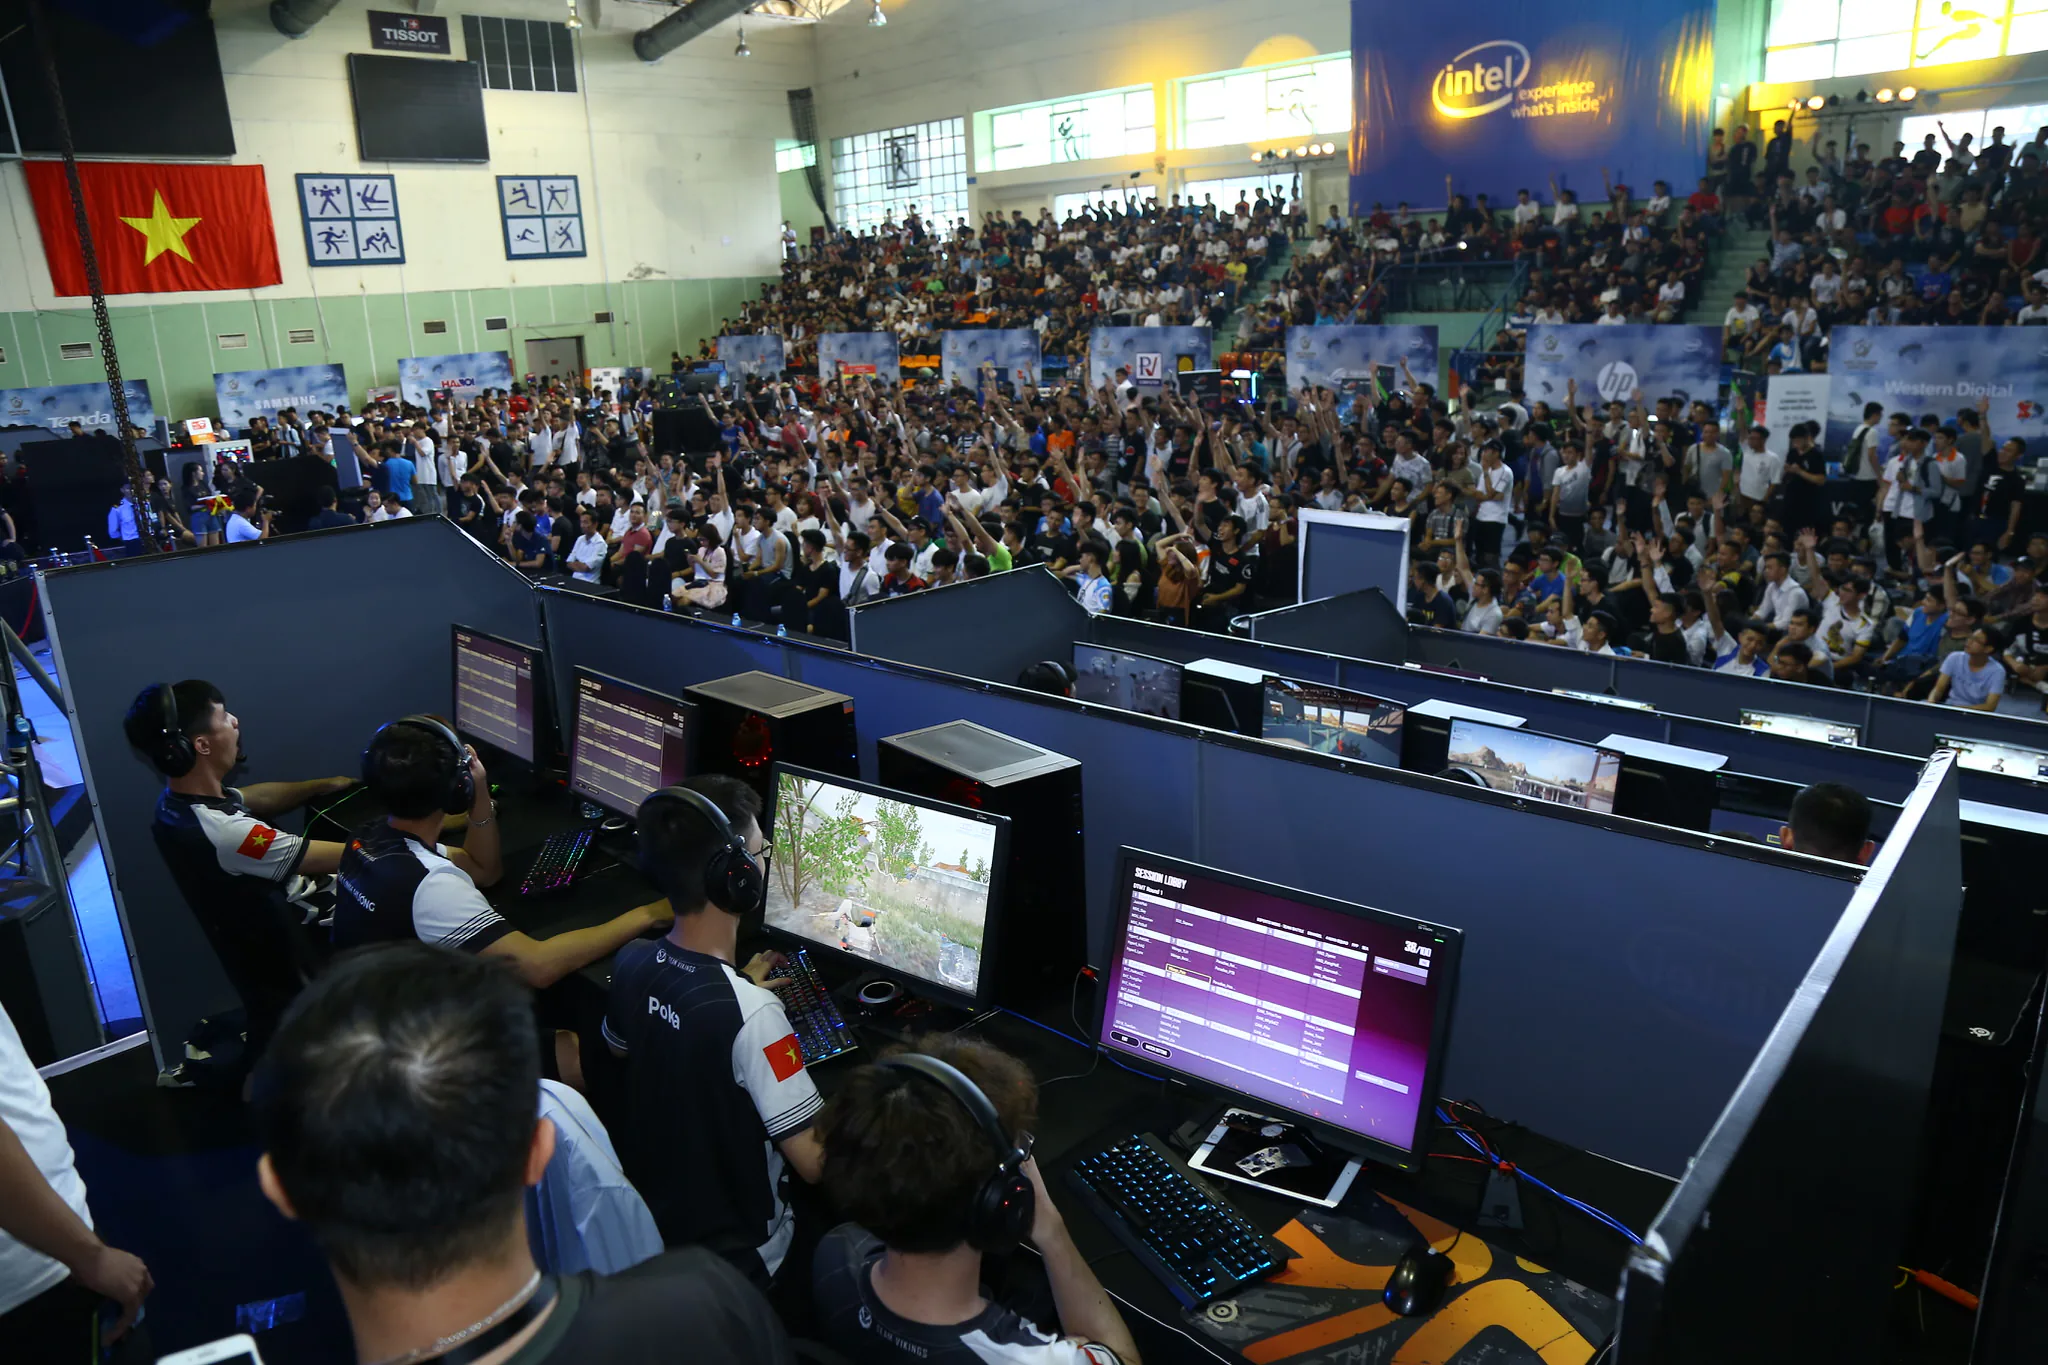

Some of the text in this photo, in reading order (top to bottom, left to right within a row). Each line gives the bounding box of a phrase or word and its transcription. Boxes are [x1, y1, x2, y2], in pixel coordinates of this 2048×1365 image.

[382, 28, 438, 43] TISSOT
[1444, 55, 1512, 96] intel
[1519, 81, 1595, 101] experience
[1512, 101, 1554, 117] what's
[1601, 361, 1634, 402] hp
[1884, 380, 1954, 397] Western
[254, 395, 317, 410] SAMSUNG
[48, 411, 111, 428] Tenda
[1134, 866, 1187, 890] SESSION LOBBY
[1404, 940, 1432, 958] 38/100
[648, 996, 681, 1030] Poka
[895, 1337, 928, 1358] VIKINGS
